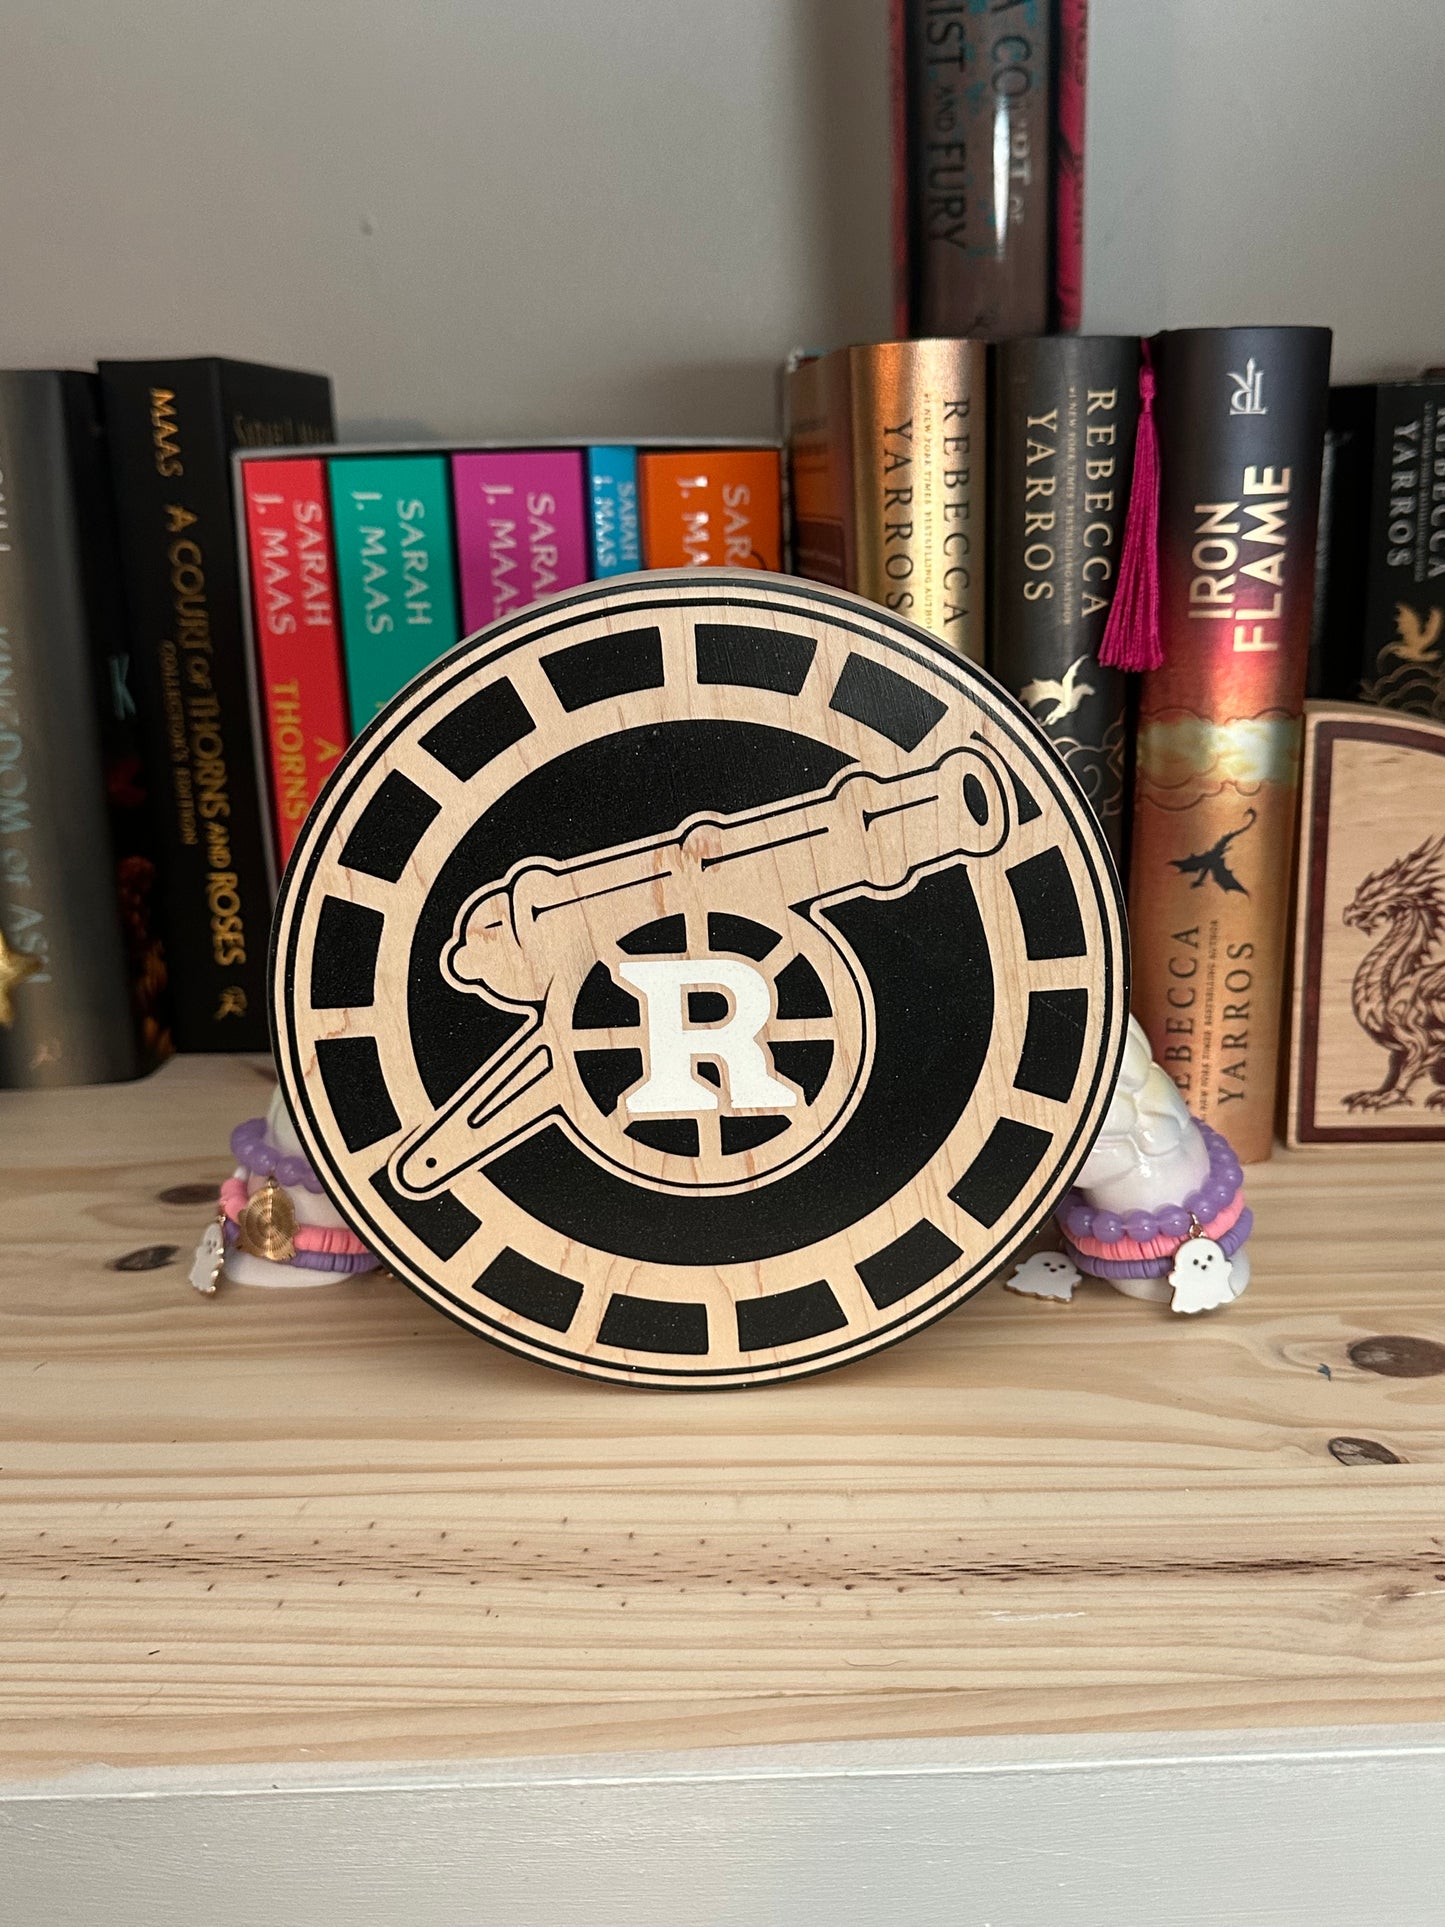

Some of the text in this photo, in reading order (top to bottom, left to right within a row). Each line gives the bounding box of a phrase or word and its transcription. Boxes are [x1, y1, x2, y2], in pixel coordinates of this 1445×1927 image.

[926, 0, 965, 72] IST
[991, 36, 1031, 186] CORT
[926, 142, 966, 249] FURY
[151, 387, 184, 477] MAAS
[1068, 402, 1077, 428] NEW
[164, 503, 198, 532] A
[481, 482, 514, 505] J.
[593, 476, 617, 568] J. MAAS
[617, 480, 638, 561] SARAH
[677, 475, 710, 567] J. MA
[722, 483, 751, 566] SAR
[884, 418, 914, 612] YARROS
[924, 470, 932, 504] TIMES
[943, 399, 971, 627] REBECCA
[1023, 408, 1058, 601] YARROS
[1066, 465, 1076, 498] TIMES
[1081, 388, 1116, 617] REBECCA
[1386, 419, 1421, 567] YARROS
[169, 538, 213, 652] COURT
[251, 490, 297, 635] J. MAAS
[293, 501, 332, 627] SARAH
[351, 489, 393, 634] J. MAAS
[397, 498, 432, 625] SARAH
[527, 492, 558, 599] SARA
[924, 511, 932, 584] BESTSELLING
[1188, 501, 1240, 619] IRON
[1233, 465, 1291, 653] FLAME
[189, 692, 231, 818] THORNS
[272, 679, 309, 821] THORNS
[313, 736, 342, 763] A
[174, 766, 198, 845] EDITION
[205, 820, 231, 869] AND
[205, 871, 246, 966] ROSES
[620, 960, 798, 1113] R
[1165, 925, 1200, 1105] EBECCA
[1218, 942, 1254, 1105] YARROS
